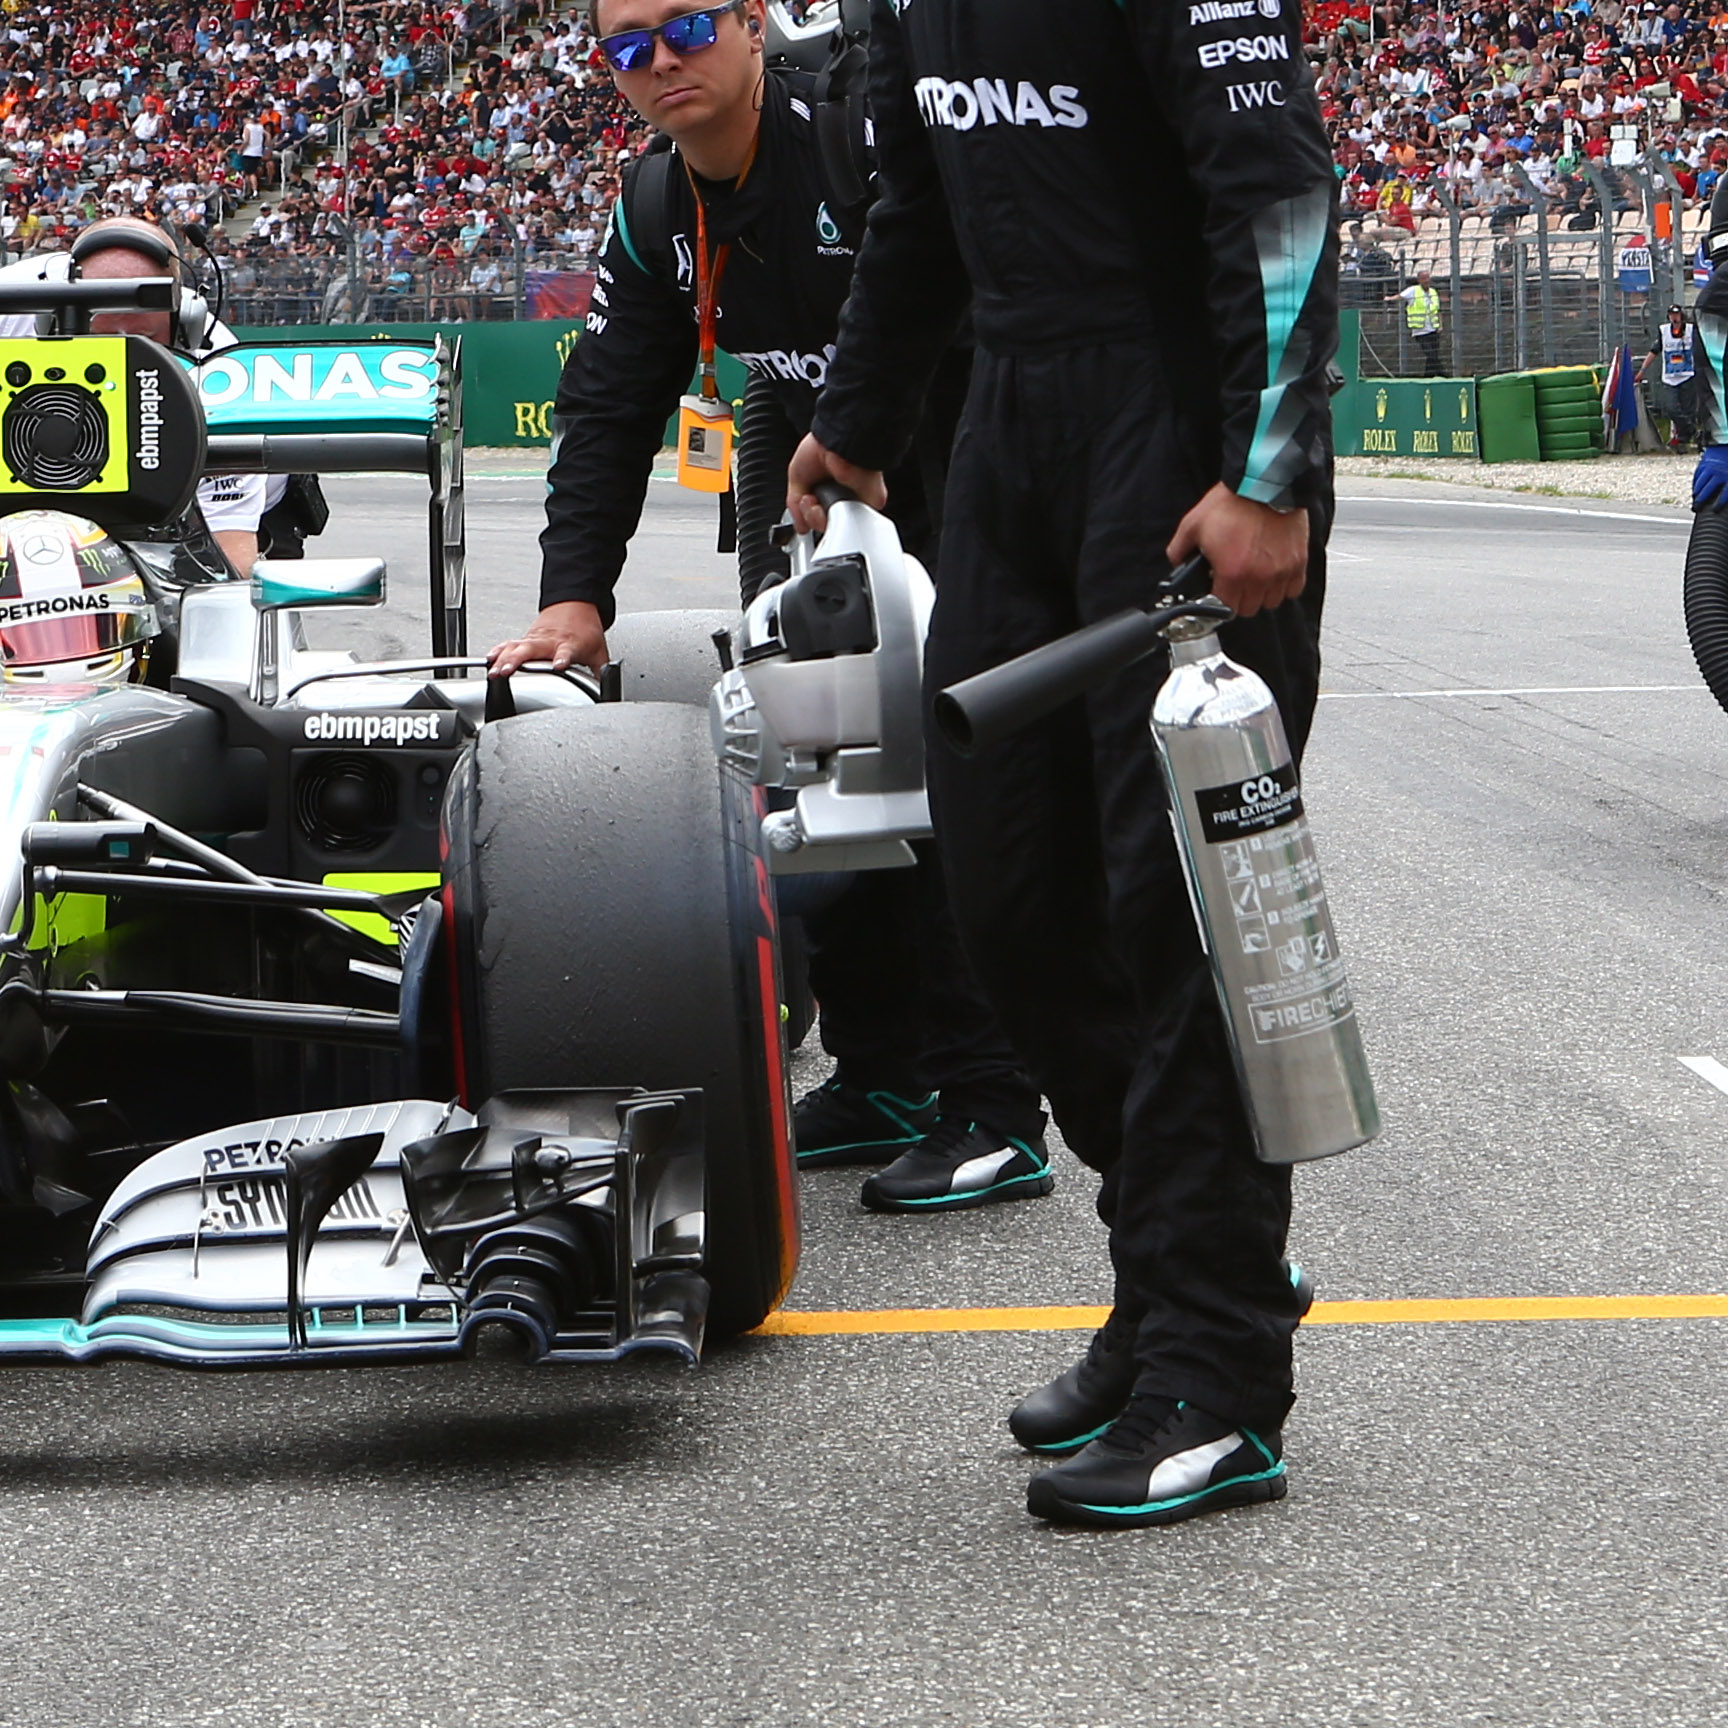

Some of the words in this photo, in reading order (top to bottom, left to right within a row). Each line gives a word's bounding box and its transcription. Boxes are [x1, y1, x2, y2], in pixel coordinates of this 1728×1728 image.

[1188, 0, 1257, 26] Allianz
[1198, 34, 1290, 69] EPSON
[1225, 79, 1287, 112] IWC
[186, 350, 433, 407] ONAS
[135, 369, 164, 470] ebmpapst
[1363, 429, 1397, 452] ROLEX
[213, 478, 245, 492] IWC
[304, 712, 441, 747] ebmpapst
[1212, 807, 1239, 825] FIRE
